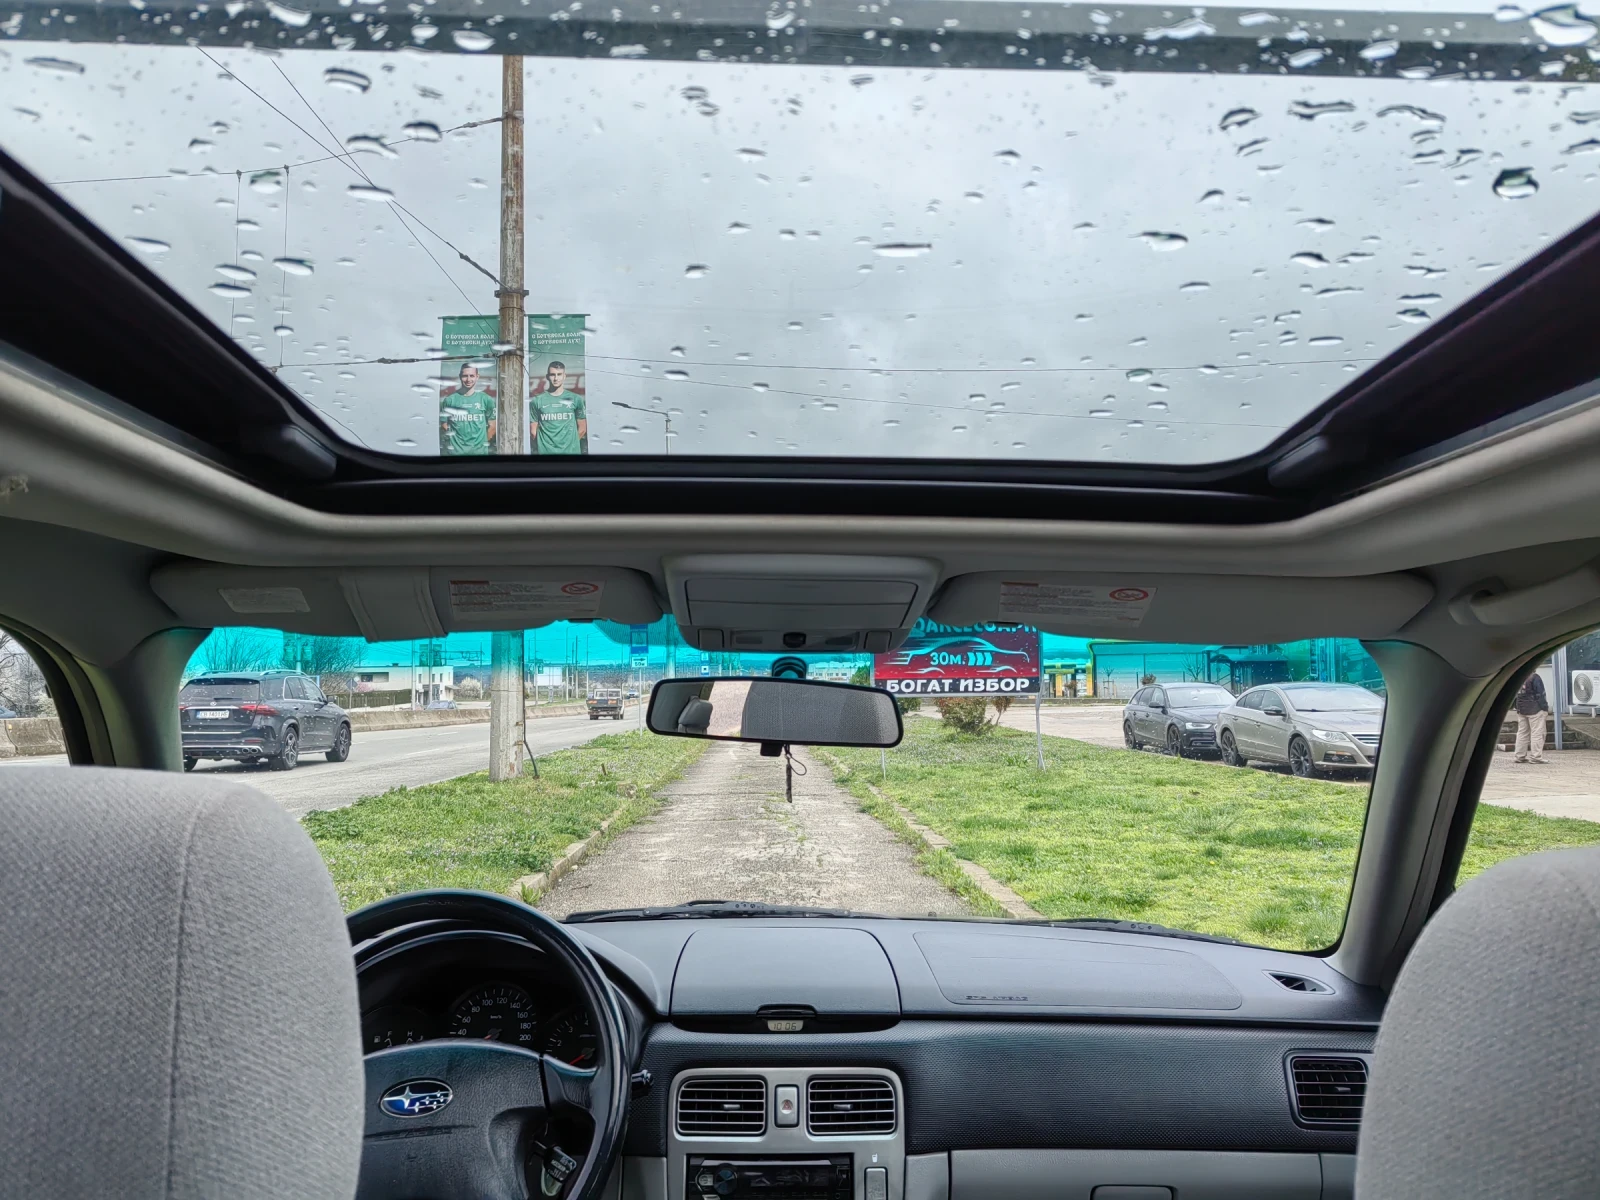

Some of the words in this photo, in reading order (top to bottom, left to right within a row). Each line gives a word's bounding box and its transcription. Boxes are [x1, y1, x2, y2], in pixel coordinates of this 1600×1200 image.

[452, 413, 484, 422] WINBET
[540, 413, 573, 421] WINBET
[886, 679, 953, 692] БОГАТ
[959, 678, 1030, 692] ИЗБОР
